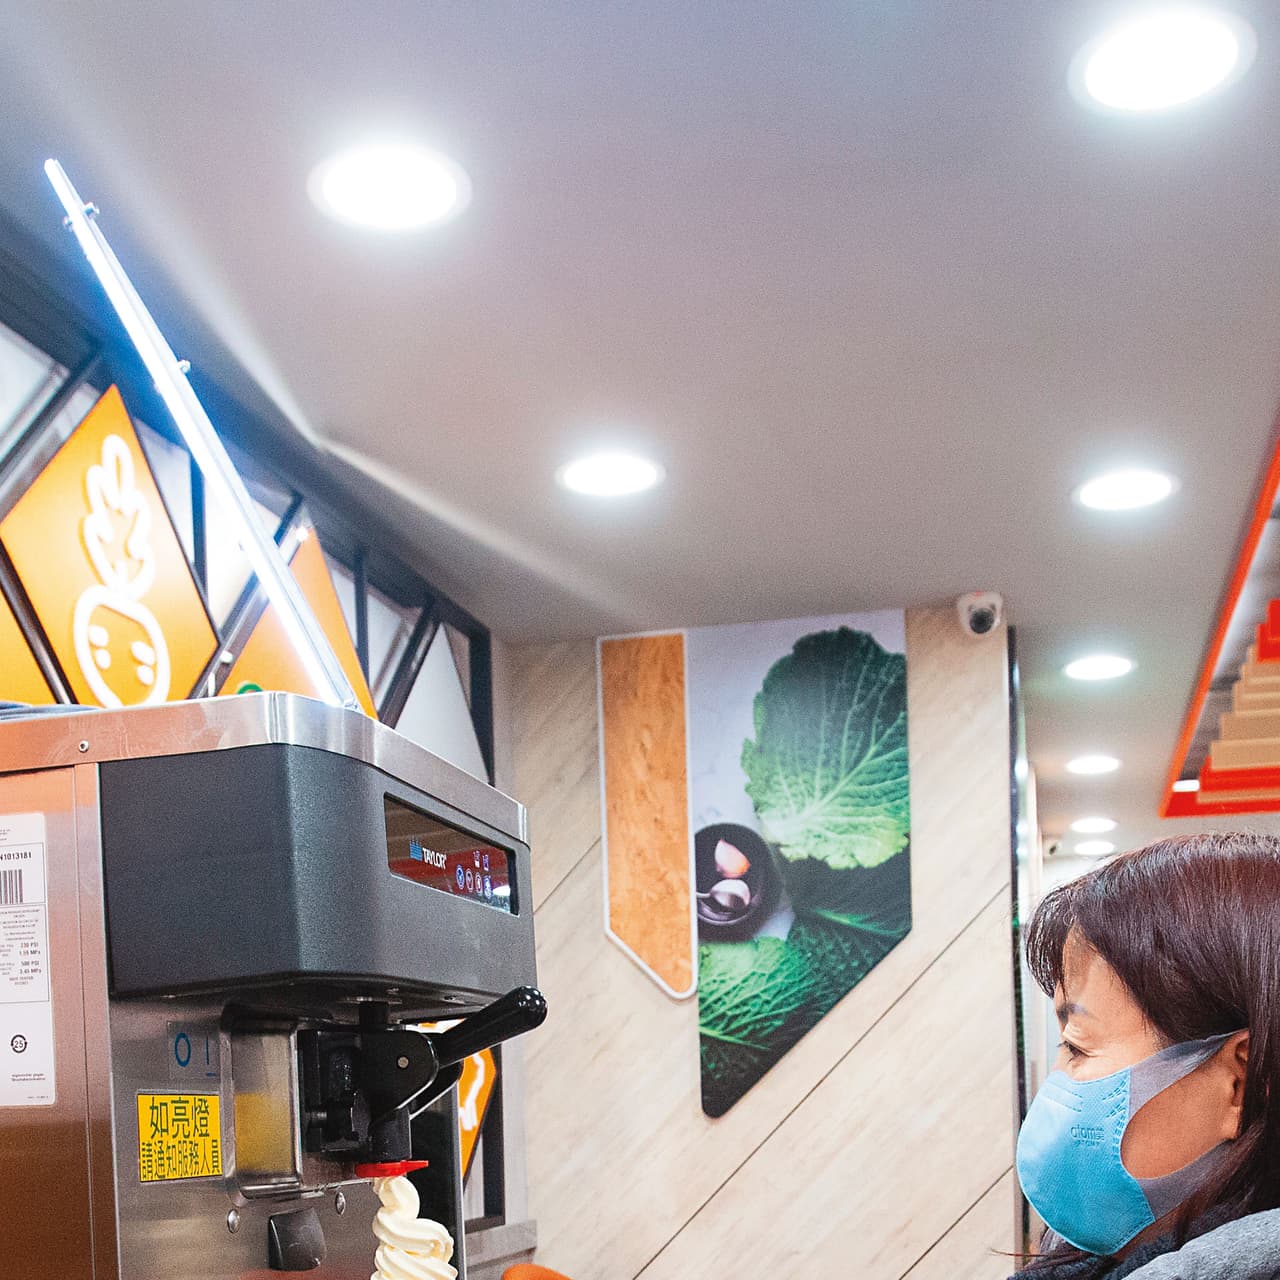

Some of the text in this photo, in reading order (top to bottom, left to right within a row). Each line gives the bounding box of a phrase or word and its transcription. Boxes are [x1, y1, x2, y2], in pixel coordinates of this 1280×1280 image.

[422, 847, 447, 870] TAYLOR
[14, 1039, 24, 1049] 25
[149, 1096, 210, 1140] 如亮燈
[141, 1138, 221, 1180] 請通知服務人員
